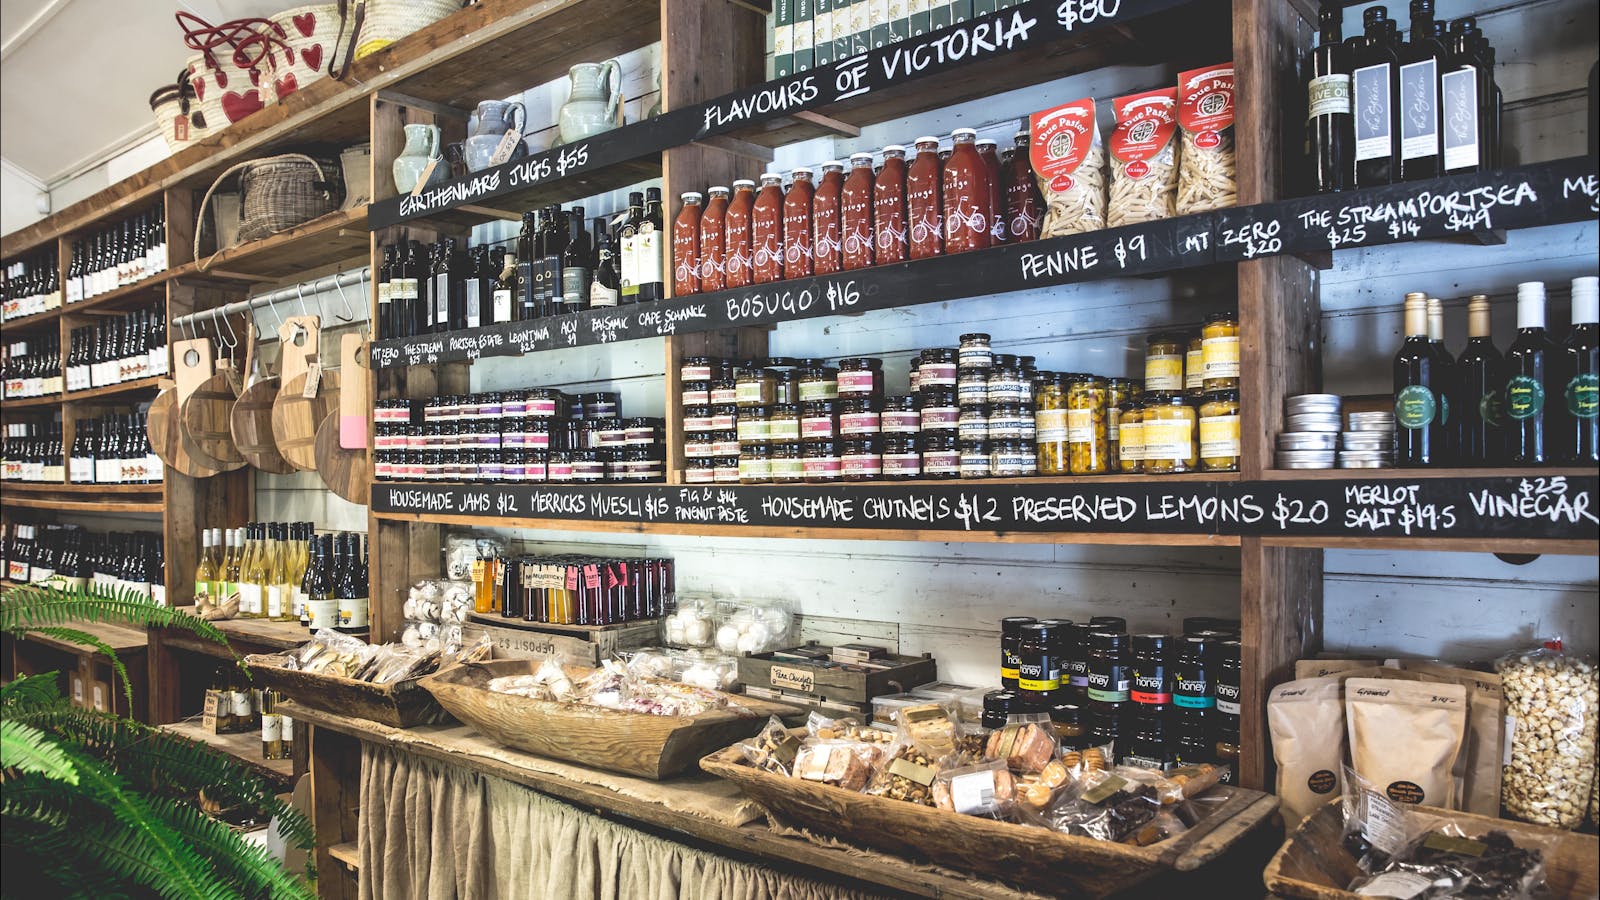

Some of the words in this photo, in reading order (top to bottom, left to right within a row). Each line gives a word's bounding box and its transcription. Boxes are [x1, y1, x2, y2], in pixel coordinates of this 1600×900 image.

[704, 76, 818, 130] FLAVOURS
[836, 62, 869, 92] OF
[882, 10, 1037, 79] VICTORIA
[1057, 0, 1120, 31] $80
[1188, 85, 1211, 101] Due
[1334, 88, 1350, 97] OIL
[1039, 124, 1058, 142] Due
[1059, 118, 1089, 135] Pastori
[1124, 112, 1144, 127] Due
[400, 170, 500, 216] EARTHENWARE
[509, 157, 551, 186] JUGS
[556, 143, 589, 176] $55
[1417, 182, 1538, 218] PORTSEA
[1298, 209, 1332, 230] THE
[1337, 198, 1418, 225] STREAM
[1444, 207, 1492, 231] $49
[1185, 231, 1209, 252] MT
[1222, 219, 1281, 245] ZERO
[1327, 224, 1366, 249] $25
[1388, 219, 1421, 239] $14
[1021, 246, 1098, 279] PENNE
[1114, 234, 1146, 268] $9
[1243, 237, 1282, 258] $20
[726, 290, 813, 320] BOSUGO
[826, 280, 860, 310] $16
[591, 316, 629, 331] BALSAMIC
[638, 311, 661, 326] CAPE
[664, 304, 706, 322] SCHANCK
[560, 319, 577, 334] ACV
[450, 335, 477, 351] PORTSEA
[478, 333, 503, 349] ESTATE
[371, 347, 381, 360] MT
[381, 347, 399, 359] ZERO
[679, 488, 699, 503] FIG
[703, 487, 712, 501] &
[716, 489, 738, 507] $14
[1345, 484, 1421, 506] MERLOT
[1518, 476, 1569, 497] $25
[389, 488, 453, 511] HOUSEMADE
[458, 492, 490, 513] JAMS
[496, 493, 518, 516] $12
[531, 490, 586, 514] MERRICKS
[590, 491, 642, 518] MUESLI
[644, 493, 670, 520] $15
[761, 496, 854, 521] HOUSEMADE
[863, 495, 950, 523] CHUTNEYS
[954, 493, 1001, 531] $12
[1012, 495, 1137, 523] PRESERVED
[1146, 494, 1264, 525] LEMONS
[1271, 493, 1329, 530] $20
[1469, 489, 1599, 525] VINEGAR
[717, 505, 750, 523] PASTE
[1344, 508, 1397, 531] SALT
[1136, 676, 1162, 690] honey
[1178, 680, 1206, 694] honey
[1356, 687, 1390, 697] Ground
